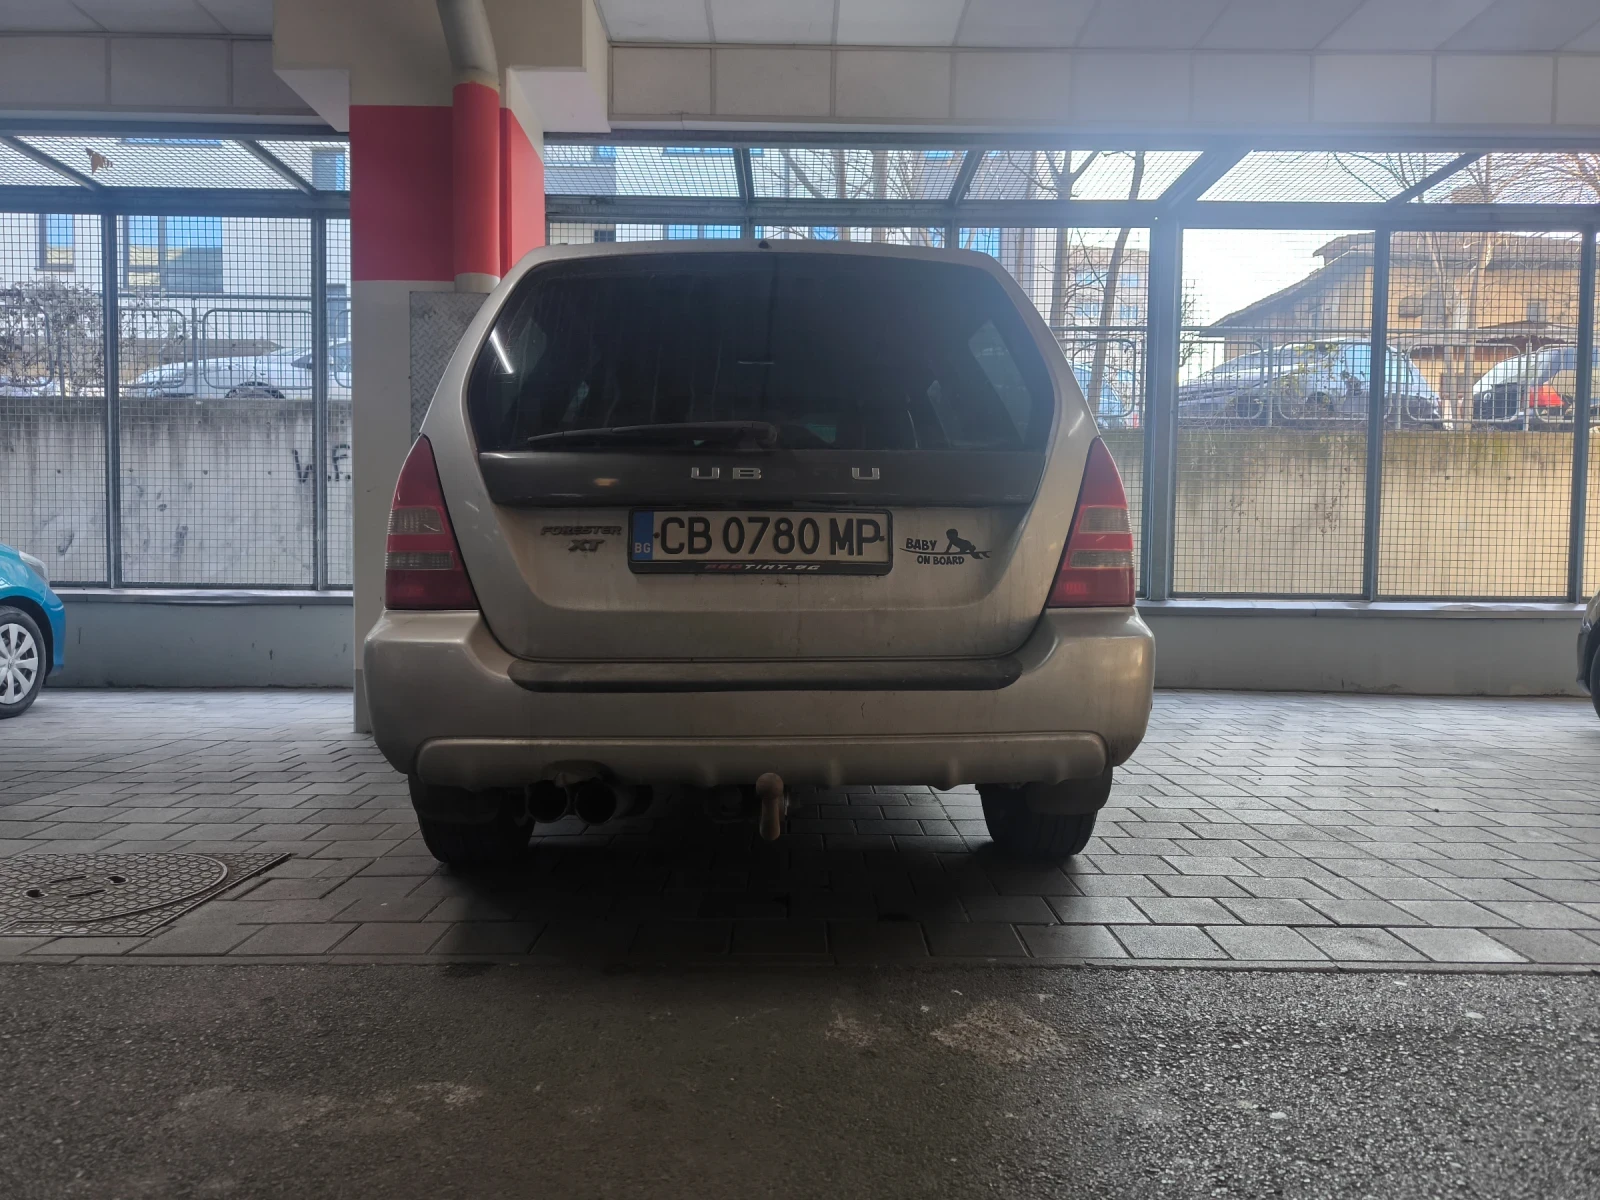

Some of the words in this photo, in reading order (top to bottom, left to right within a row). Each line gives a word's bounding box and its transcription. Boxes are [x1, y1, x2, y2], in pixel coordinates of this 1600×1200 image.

[540, 525, 623, 536] FORESTER
[660, 516, 713, 555] CB
[722, 516, 820, 555] 0780
[829, 518, 882, 556] MP
[568, 539, 606, 552] XT
[634, 542, 651, 554] BG
[905, 538, 938, 551] BABY
[916, 555, 931, 565] ON
[933, 556, 965, 566] BOARD
